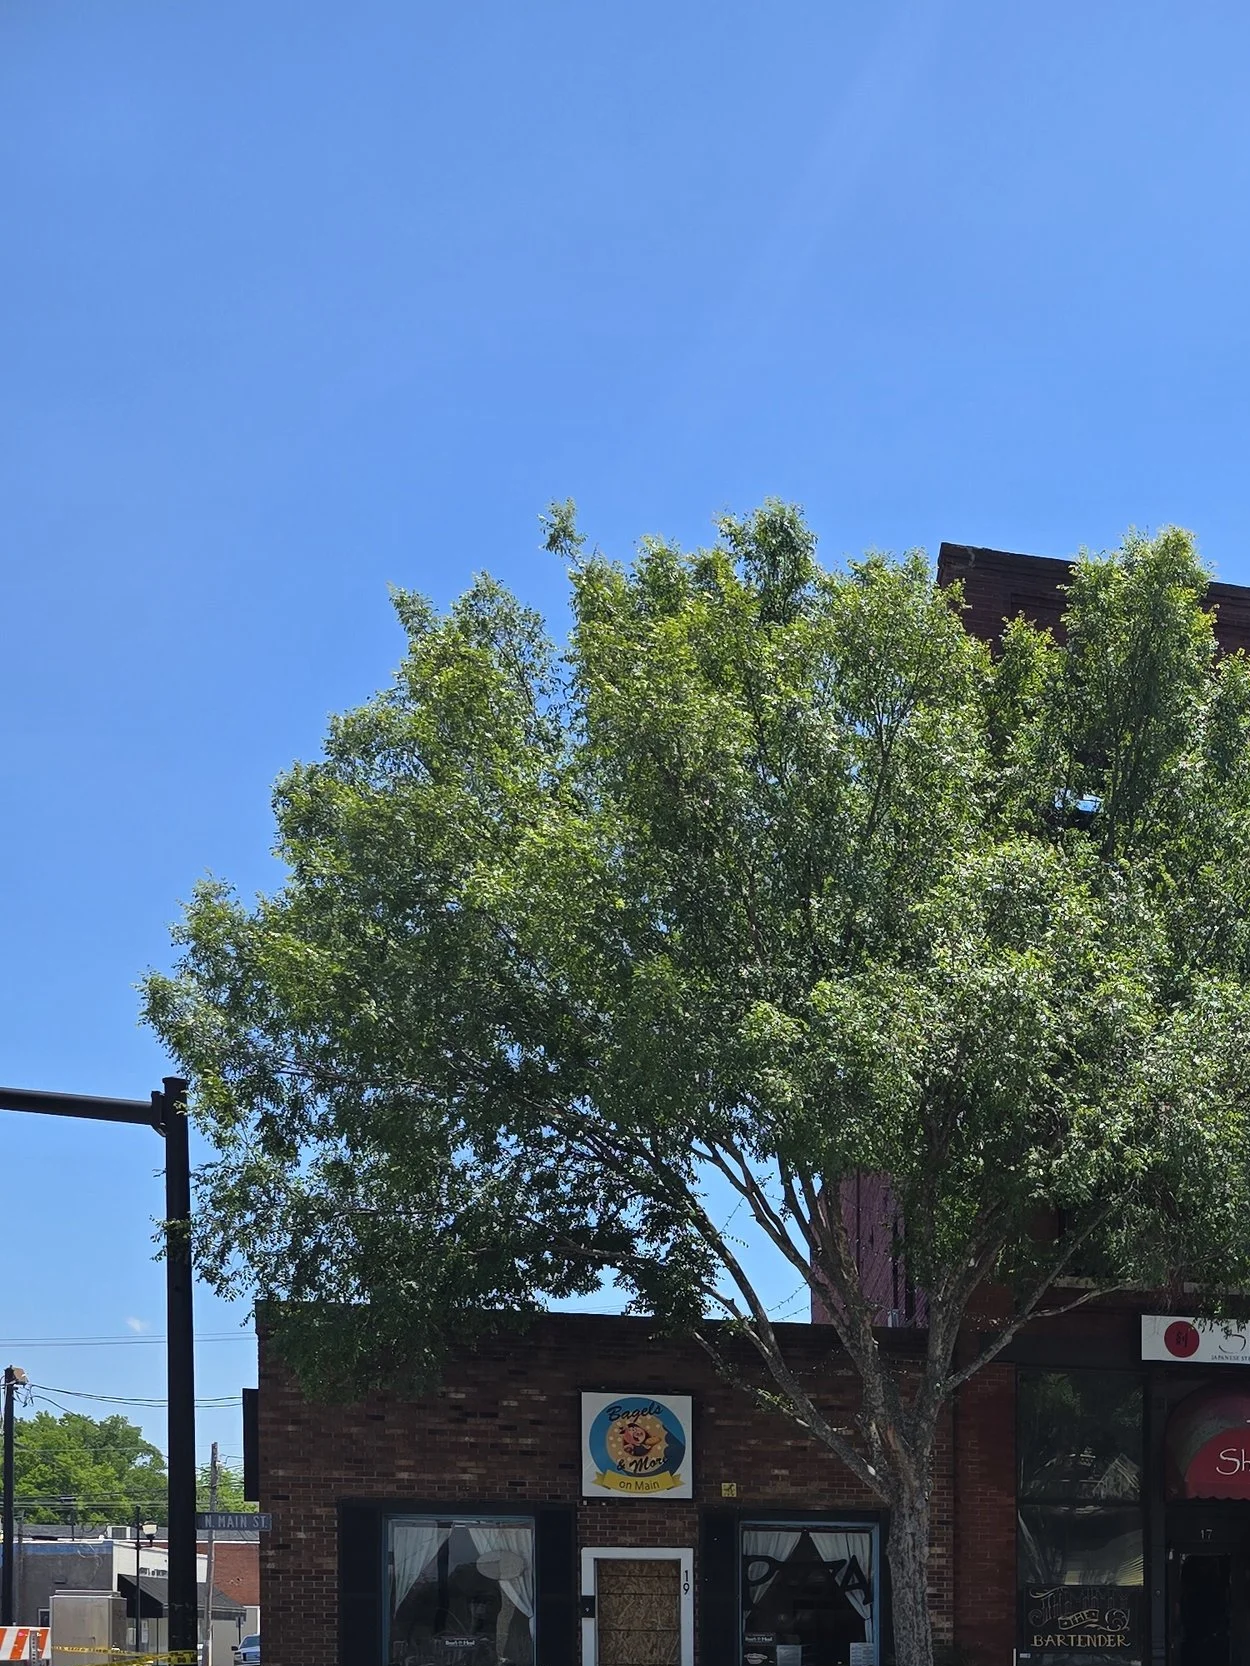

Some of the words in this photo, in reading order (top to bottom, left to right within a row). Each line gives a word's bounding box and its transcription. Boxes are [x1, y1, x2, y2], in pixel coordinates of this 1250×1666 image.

[607, 1401, 663, 1422] Bagels
[619, 1481, 631, 1490] on
[635, 1481, 660, 1491] Main
[205, 1515, 215, 1528] N.
[218, 1515, 247, 1528] MAIN
[252, 1515, 268, 1528] ST.
[1201, 1529, 1213, 1540] 17
[1030, 1634, 1131, 1648] BARTENDER
